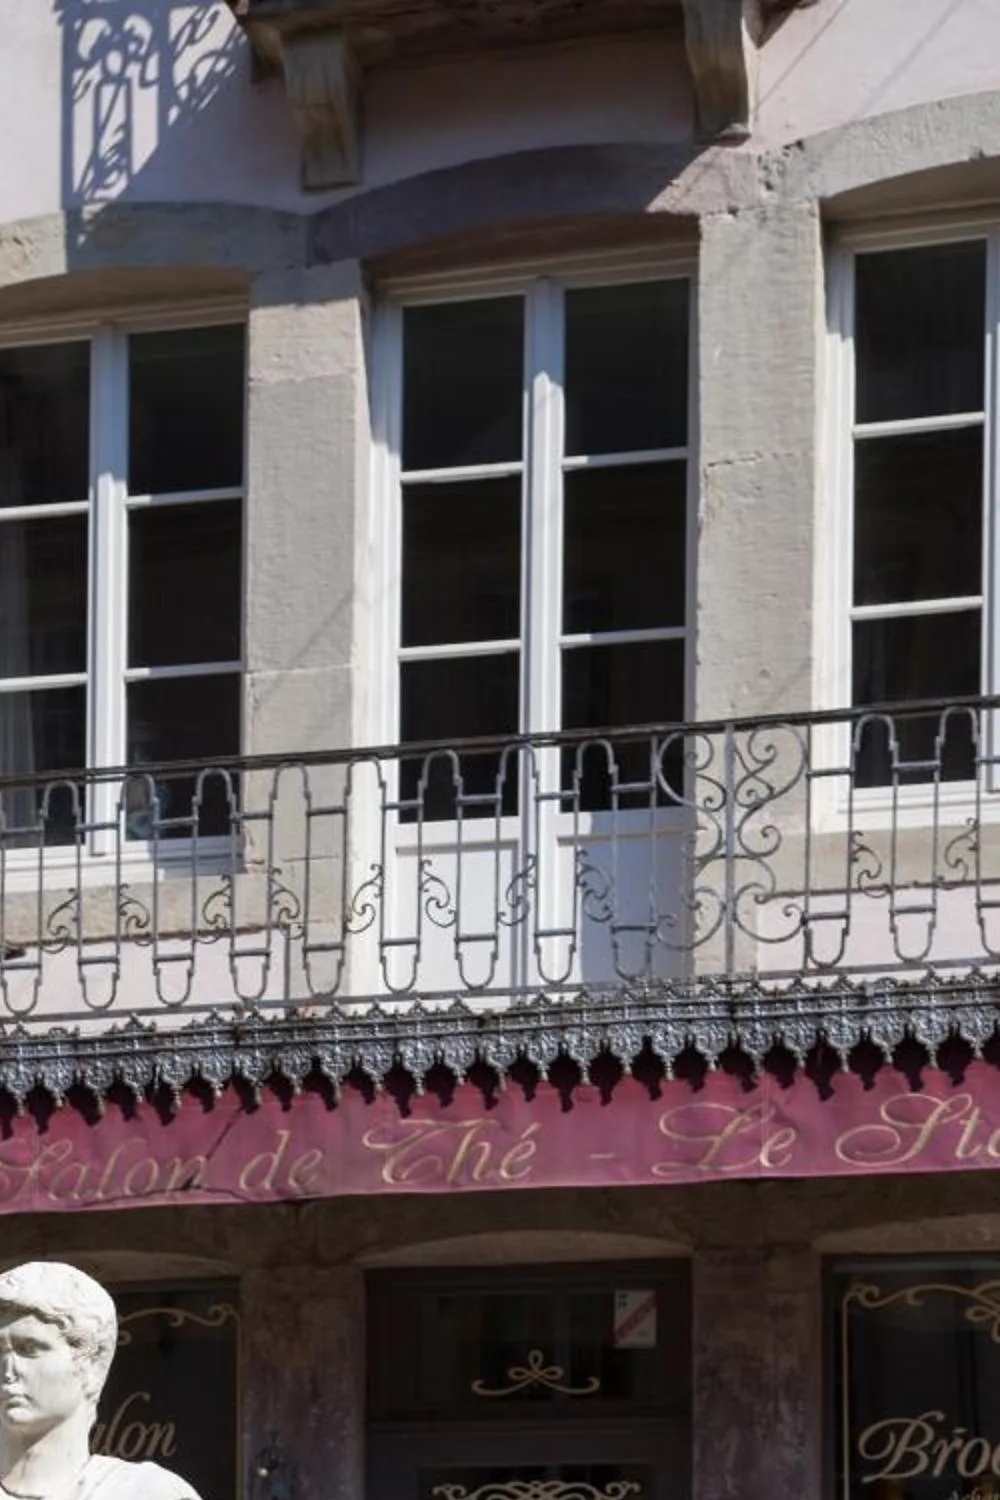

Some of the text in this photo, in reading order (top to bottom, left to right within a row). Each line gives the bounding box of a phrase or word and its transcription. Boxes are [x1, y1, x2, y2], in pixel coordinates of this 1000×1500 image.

[238, 1129, 325, 1192] de
[361, 1118, 542, 1185] Thé
[651, 1101, 797, 1177] Le
